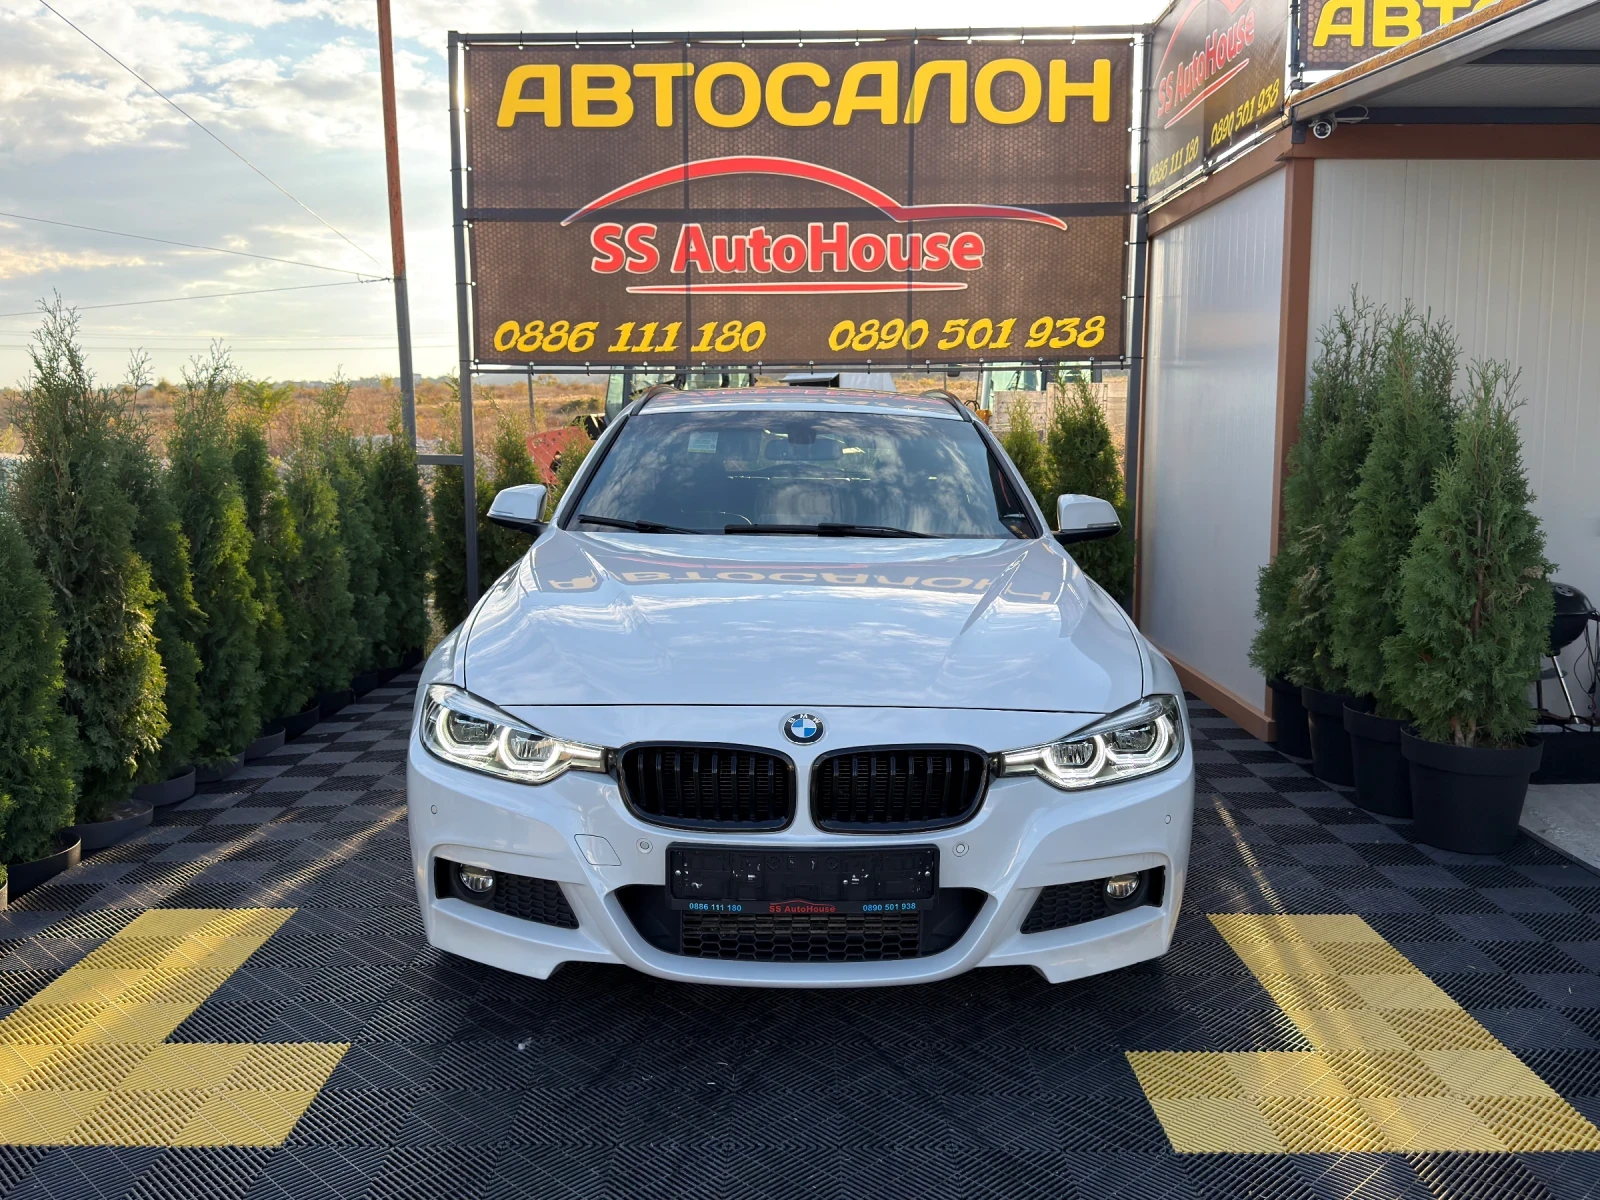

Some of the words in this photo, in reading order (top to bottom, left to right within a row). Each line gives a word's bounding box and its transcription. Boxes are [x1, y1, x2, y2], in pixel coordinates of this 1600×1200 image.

[1312, 0, 1502, 48] АВТ
[1157, 71, 1175, 118] SS
[1174, 7, 1256, 107] AutoHouse
[496, 58, 1112, 129] АВТОСАЛОН
[1211, 111, 1235, 148] 0890
[1235, 96, 1256, 132] 501
[1256, 78, 1280, 117] 938
[1169, 147, 1184, 176] 111
[1183, 135, 1199, 167] 180
[589, 222, 660, 275] SS
[671, 220, 986, 274] AutoHouse
[493, 320, 600, 353] 0886
[607, 321, 683, 353] 111
[690, 320, 767, 353] 180
[828, 318, 929, 352] 0890
[937, 317, 1017, 350] 501
[1024, 315, 1106, 348] 938
[787, 713, 821, 724] BMW
[688, 902, 709, 911] 0886
[727, 904, 742, 912] 180
[769, 905, 782, 913] SS
[784, 905, 836, 913] AutoHouse
[862, 904, 883, 912] 0890
[885, 903, 899, 911] 501
[901, 902, 916, 910] 938
